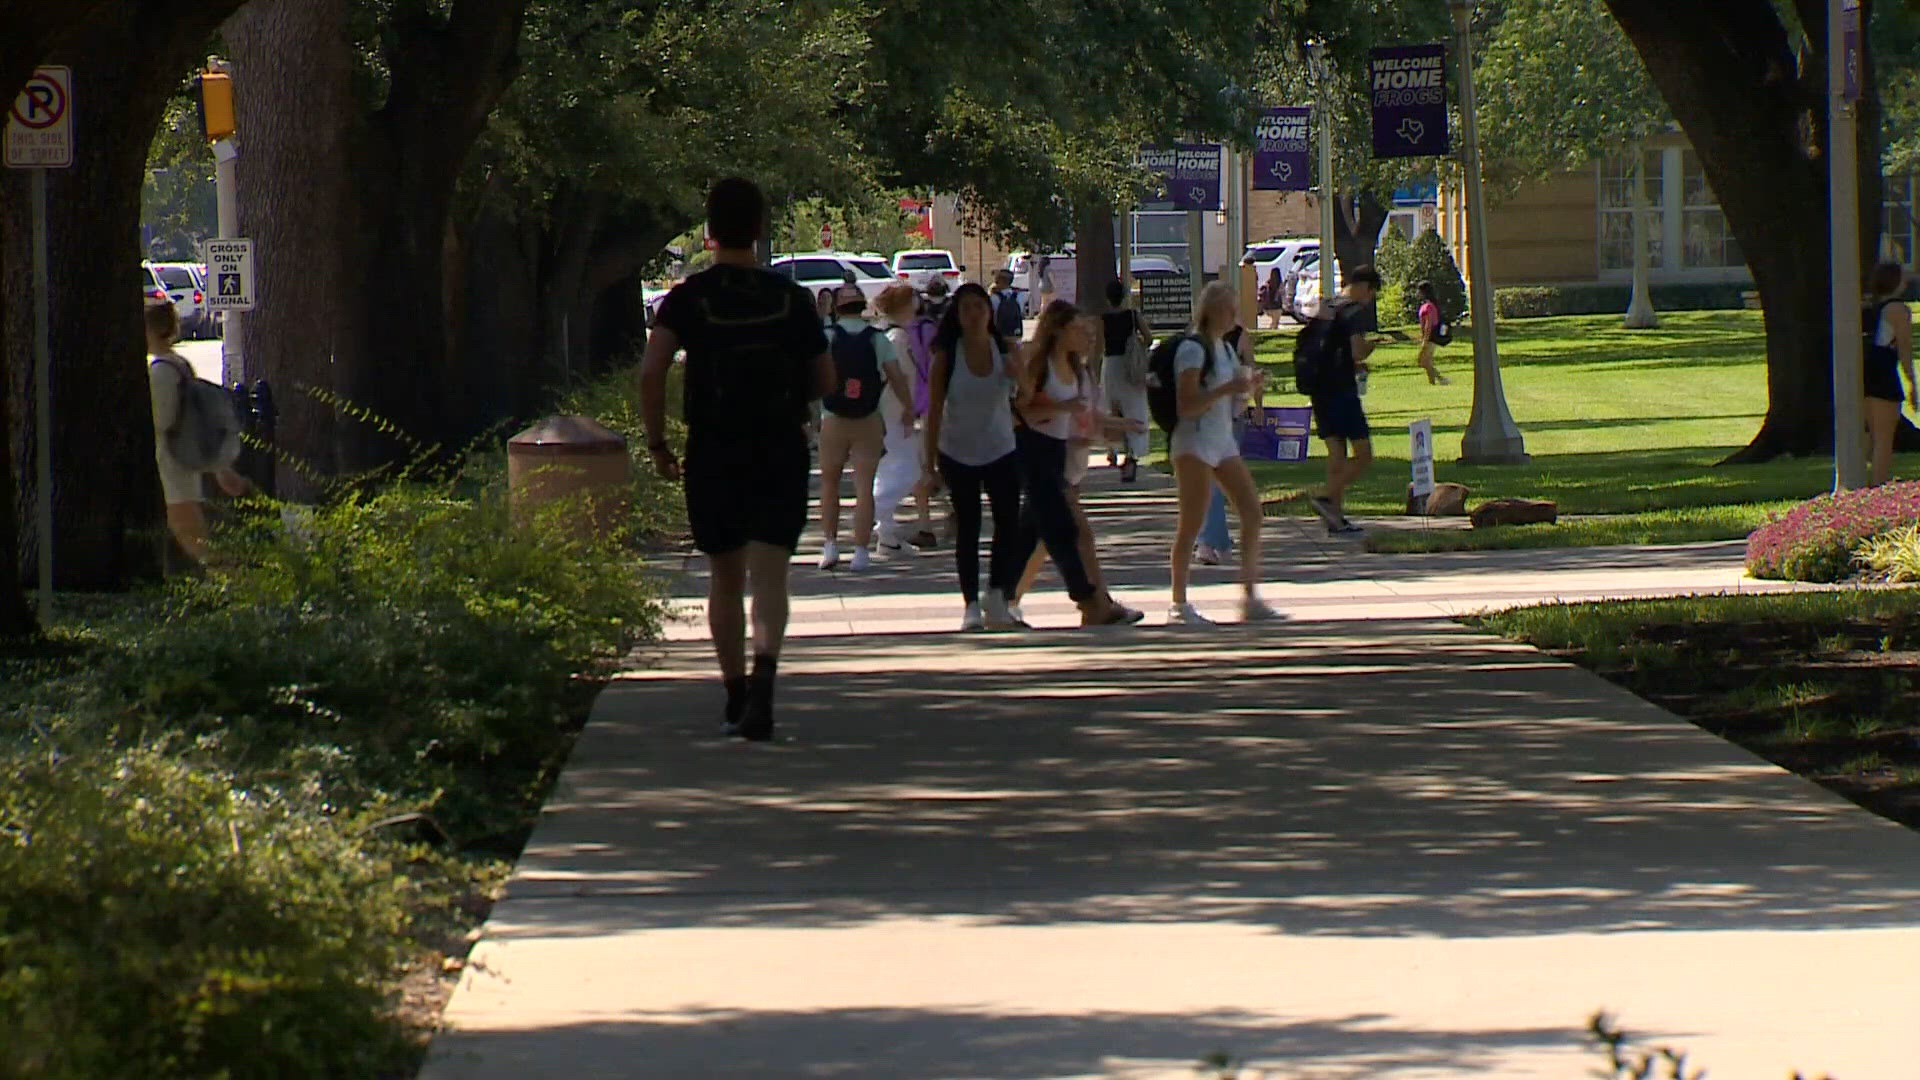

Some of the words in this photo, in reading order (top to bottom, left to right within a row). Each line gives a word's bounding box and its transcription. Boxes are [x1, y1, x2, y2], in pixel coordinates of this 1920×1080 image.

[1373, 56, 1442, 71] WELCOME
[1373, 69, 1443, 90] HOME
[1374, 87, 1443, 107] FROGS
[1256, 125, 1307, 140] HOME
[1177, 151, 1219, 159] WELCOME
[1177, 158, 1219, 171] HOME
[210, 244, 247, 253] CROSS
[214, 254, 244, 263] ONLY
[221, 264, 238, 272] ON
[210, 296, 250, 305] SIGNAL
